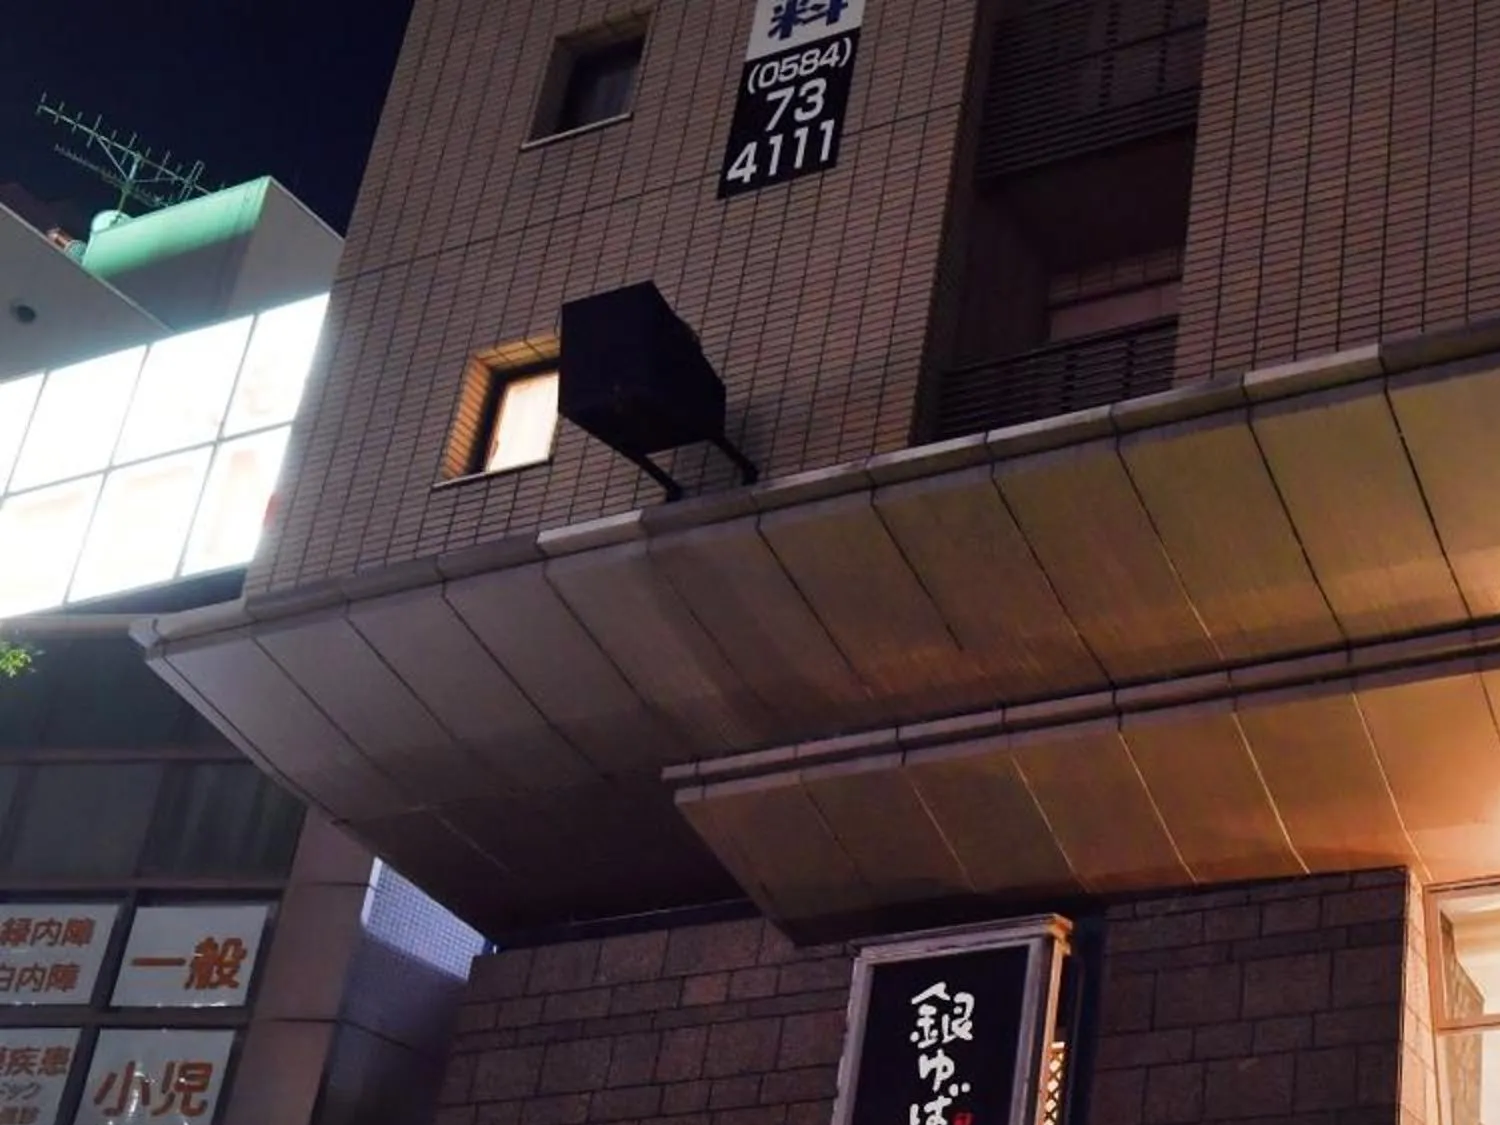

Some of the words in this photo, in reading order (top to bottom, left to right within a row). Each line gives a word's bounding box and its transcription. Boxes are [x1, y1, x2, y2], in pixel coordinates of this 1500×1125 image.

[748, 37, 851, 94] (0584)
[765, 78, 827, 132] 73
[726, 119, 835, 183] 4111
[131, 936, 247, 990] 一般
[94, 1060, 213, 1117] 小児
